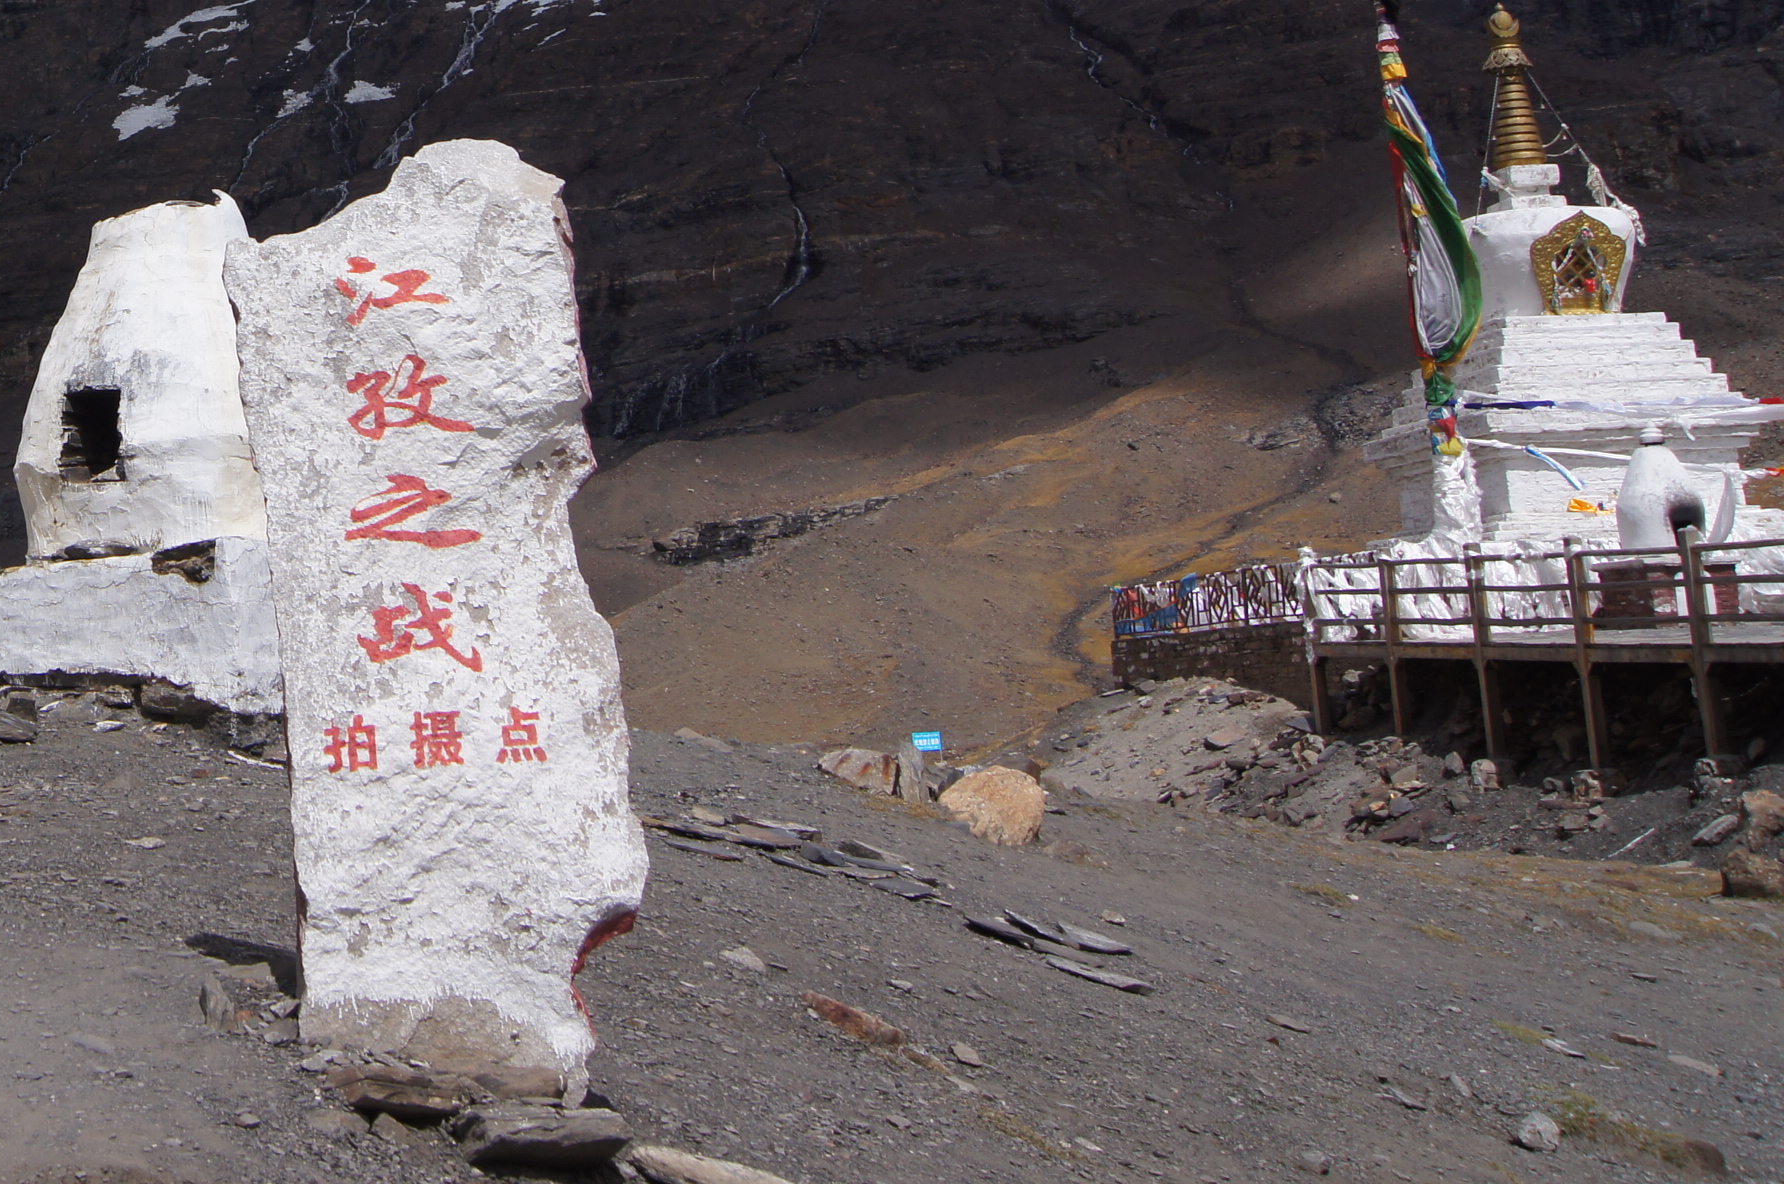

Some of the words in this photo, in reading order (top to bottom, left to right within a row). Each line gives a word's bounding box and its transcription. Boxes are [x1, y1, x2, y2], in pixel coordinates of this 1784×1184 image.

[336, 256, 483, 672] 江孜之战
[323, 707, 548, 774] 拍摄点
